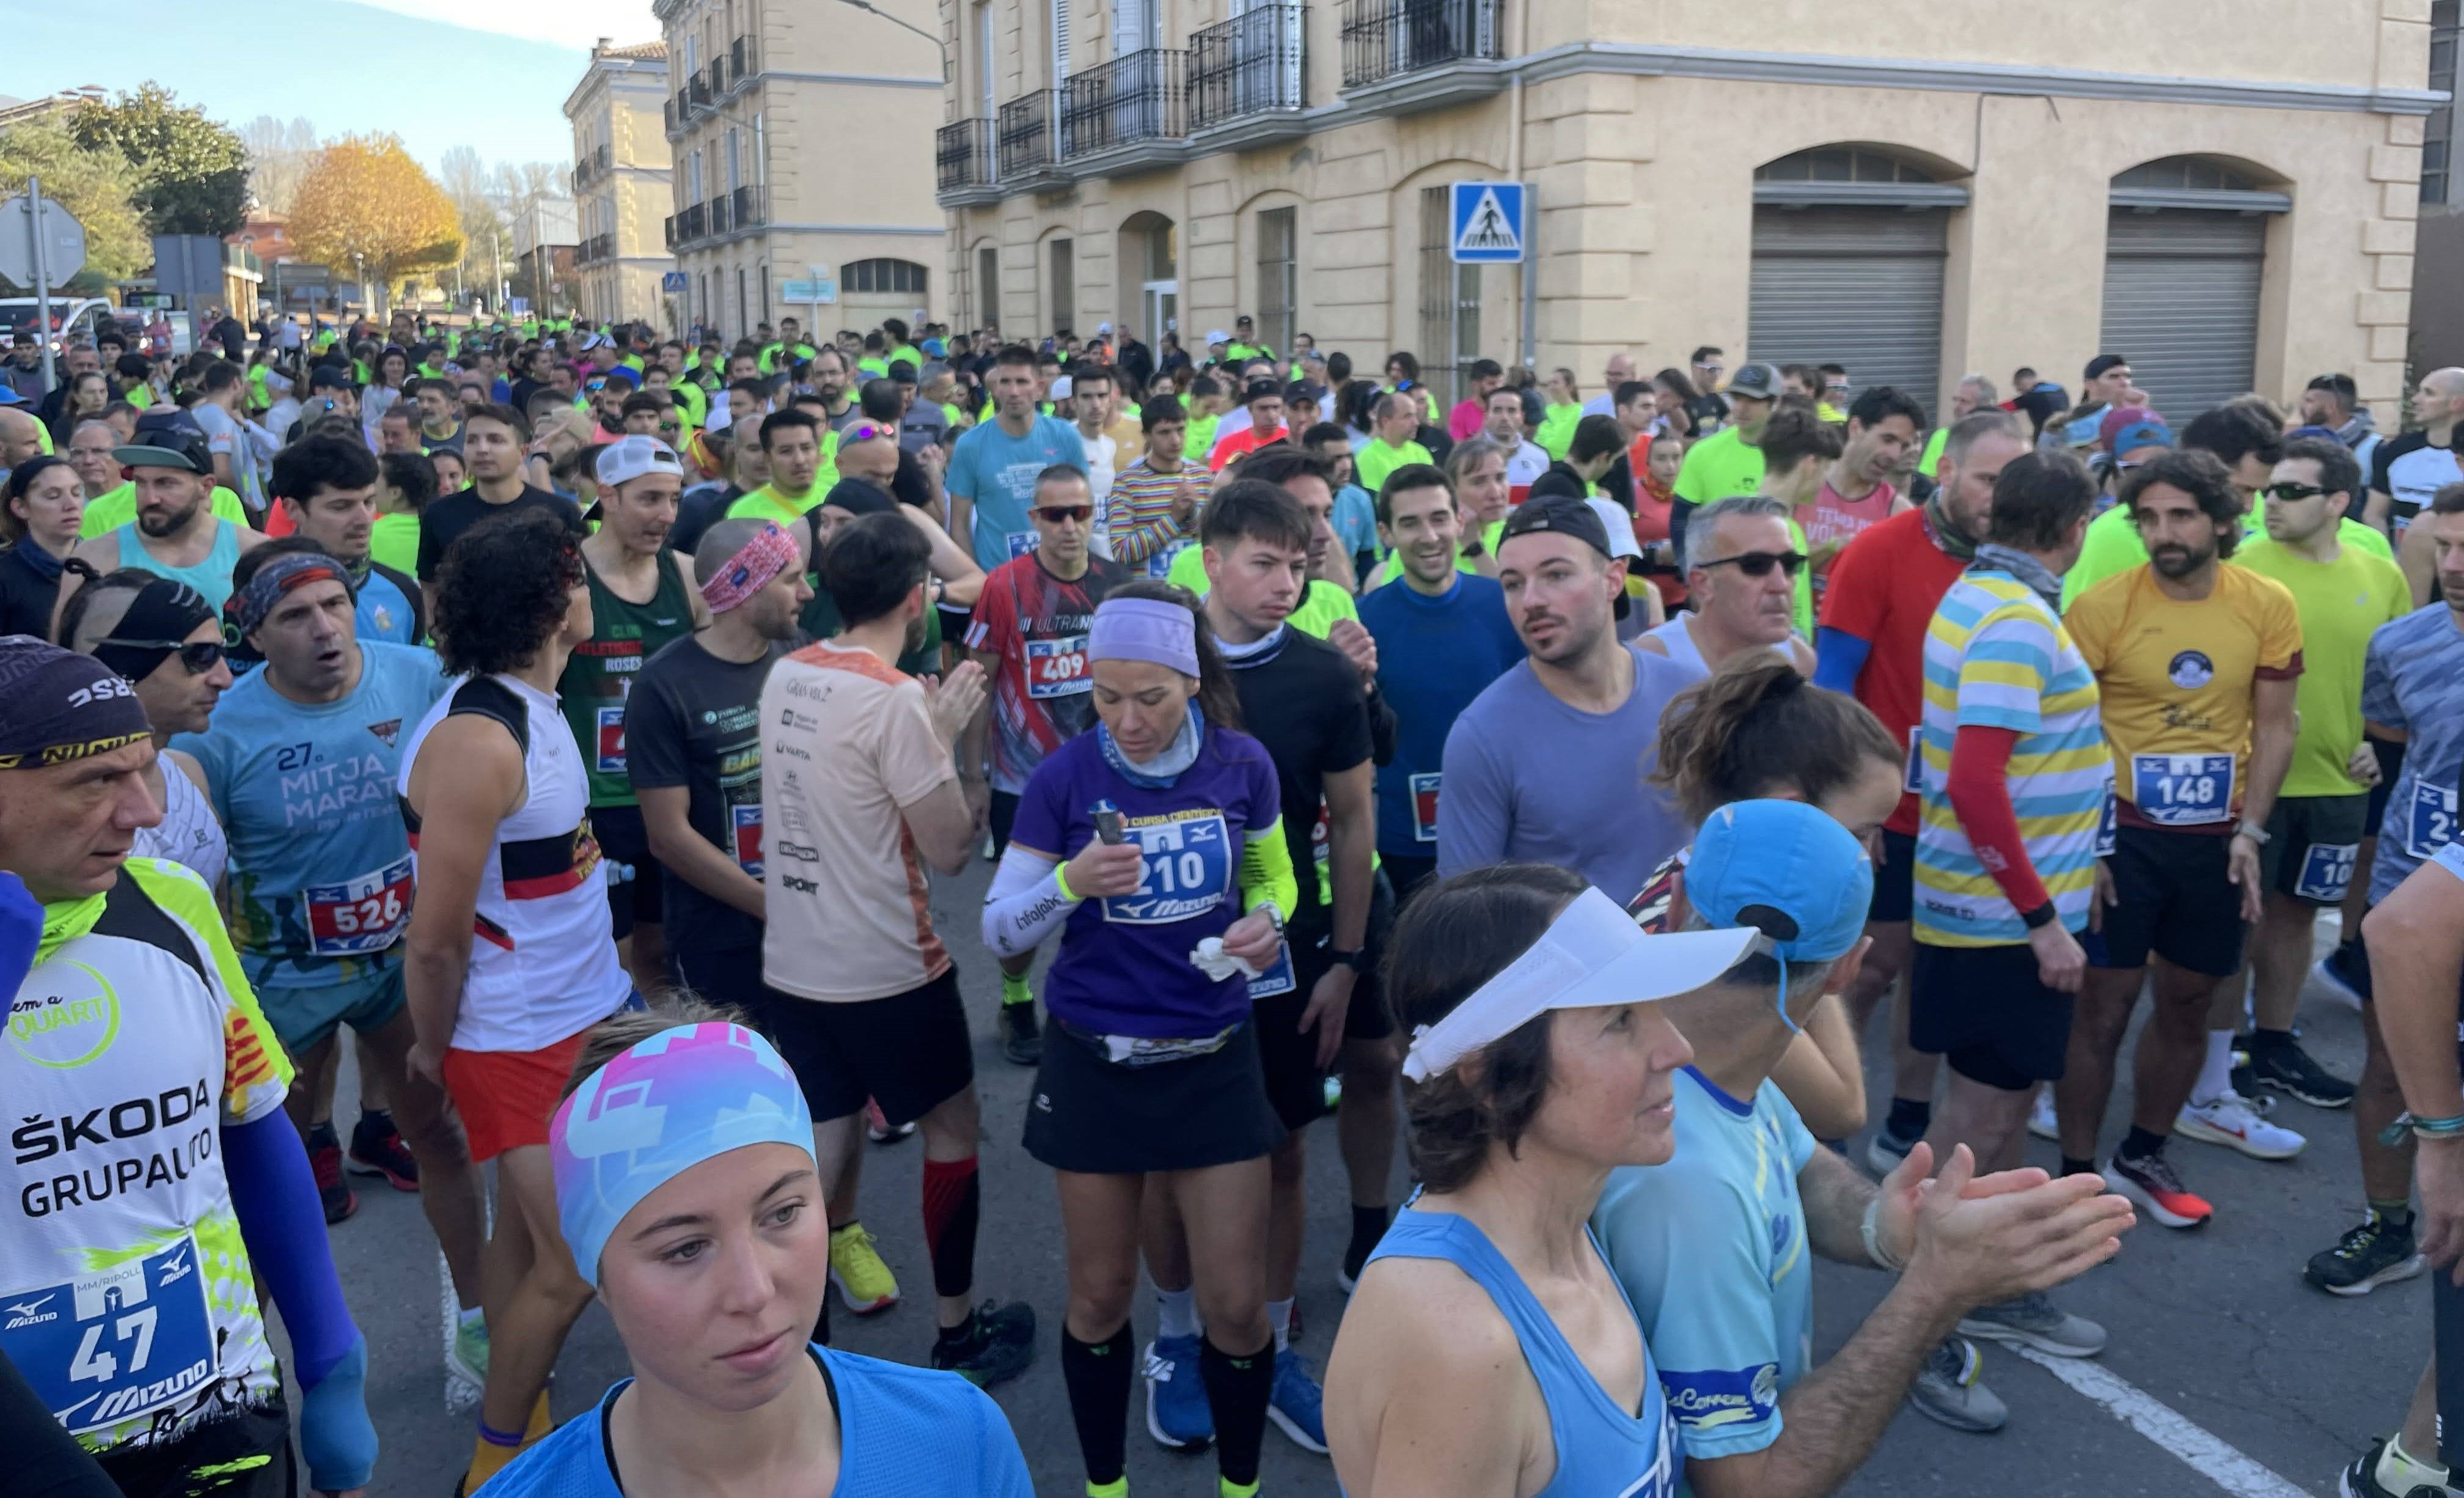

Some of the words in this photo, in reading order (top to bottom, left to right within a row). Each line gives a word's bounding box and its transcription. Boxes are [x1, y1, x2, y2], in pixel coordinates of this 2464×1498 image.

[1041, 653, 1085, 680] 409
[280, 753, 387, 799] MITJA
[2157, 776, 2216, 805] 148
[285, 774, 398, 828] MARAT
[334, 888, 402, 933] 526
[9, 996, 106, 1043] QUART
[12, 1078, 211, 1166] ŠKODA
[21, 1128, 212, 1218] GRUPAUTO
[76, 1266, 142, 1293] MM/RIPOLL
[70, 1305, 158, 1383] 47
